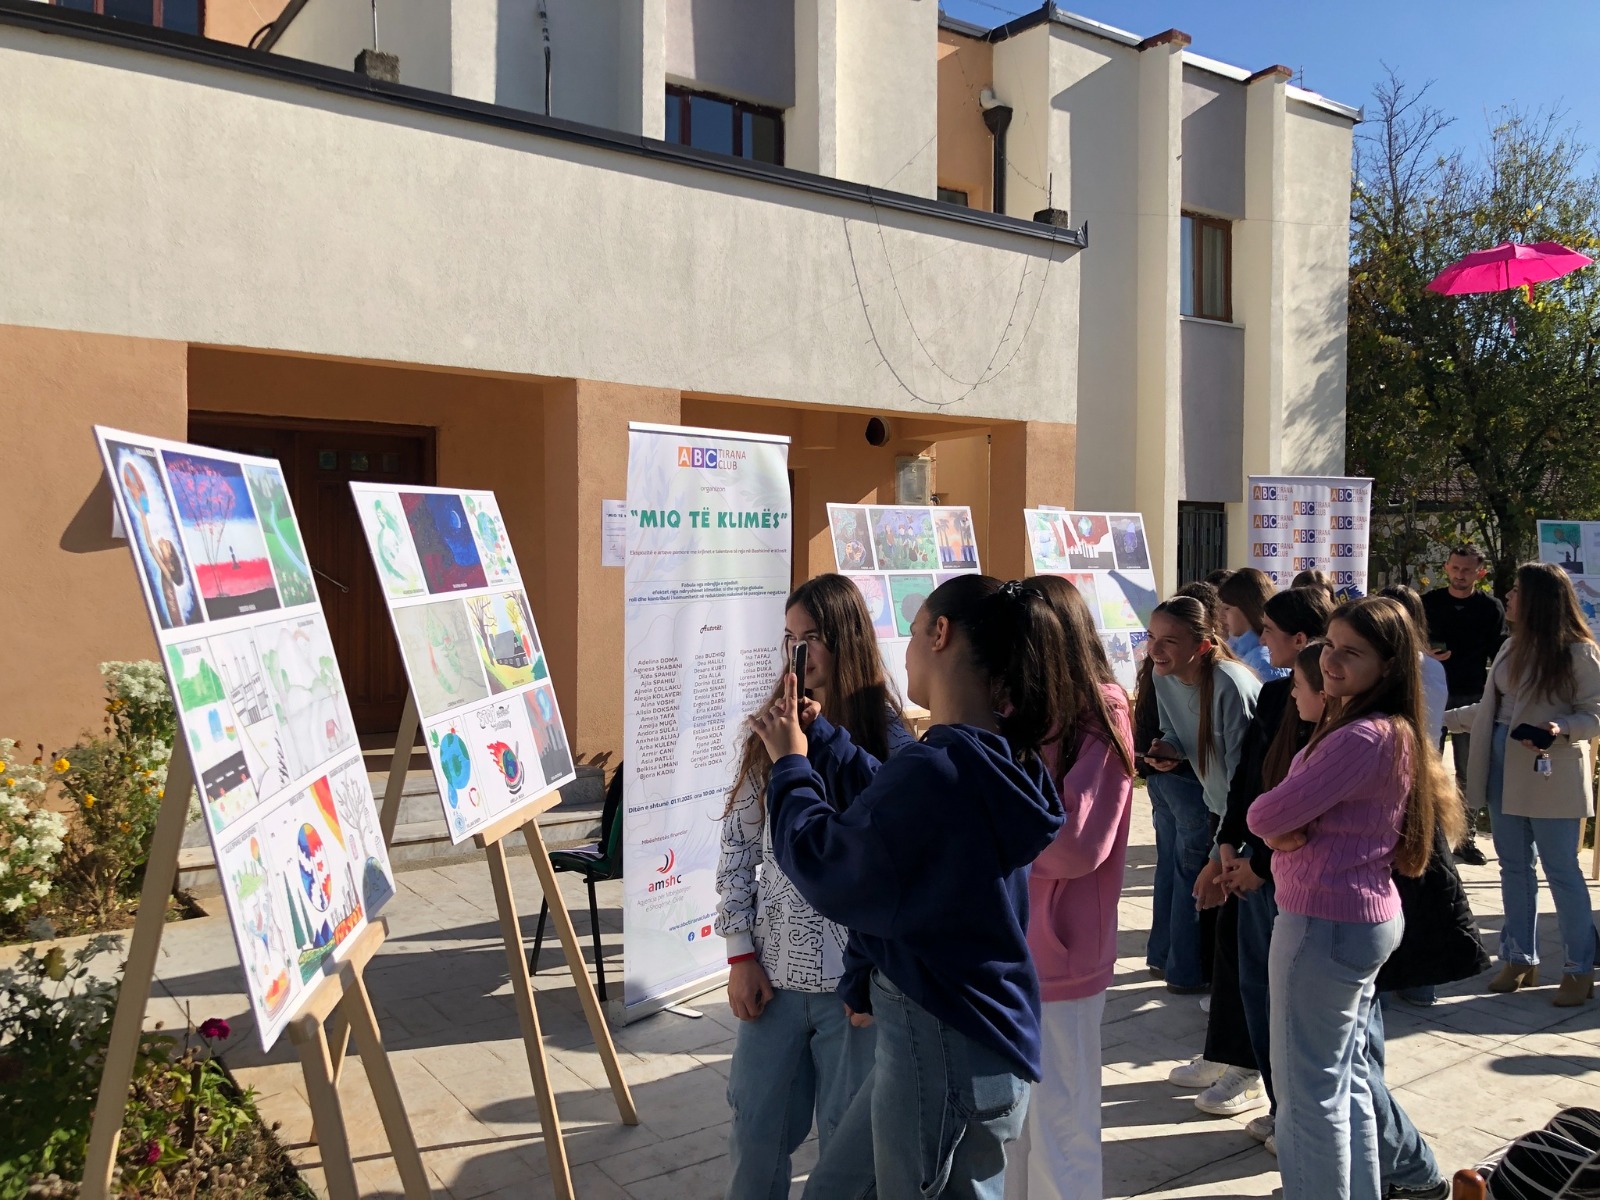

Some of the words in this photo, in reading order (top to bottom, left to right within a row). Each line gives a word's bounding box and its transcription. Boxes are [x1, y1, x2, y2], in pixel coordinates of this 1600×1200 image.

[678, 446, 718, 468] ABC
[718, 448, 746, 460] TIRANA
[718, 461, 738, 470] CLUB
[700, 485, 726, 493] organizon
[1254, 486, 1276, 500] ABC
[1331, 488, 1352, 502] ABC
[1293, 501, 1315, 515] ABC
[688, 507, 710, 529] TË
[1254, 515, 1276, 528] ABC
[1331, 516, 1352, 529] ABC
[1293, 529, 1315, 543] ABC
[1254, 543, 1277, 557] ABC
[1331, 544, 1352, 557] ABC
[1293, 557, 1315, 571] ABC
[1330, 571, 1352, 584] ABC
[648, 875, 682, 892] amshc
